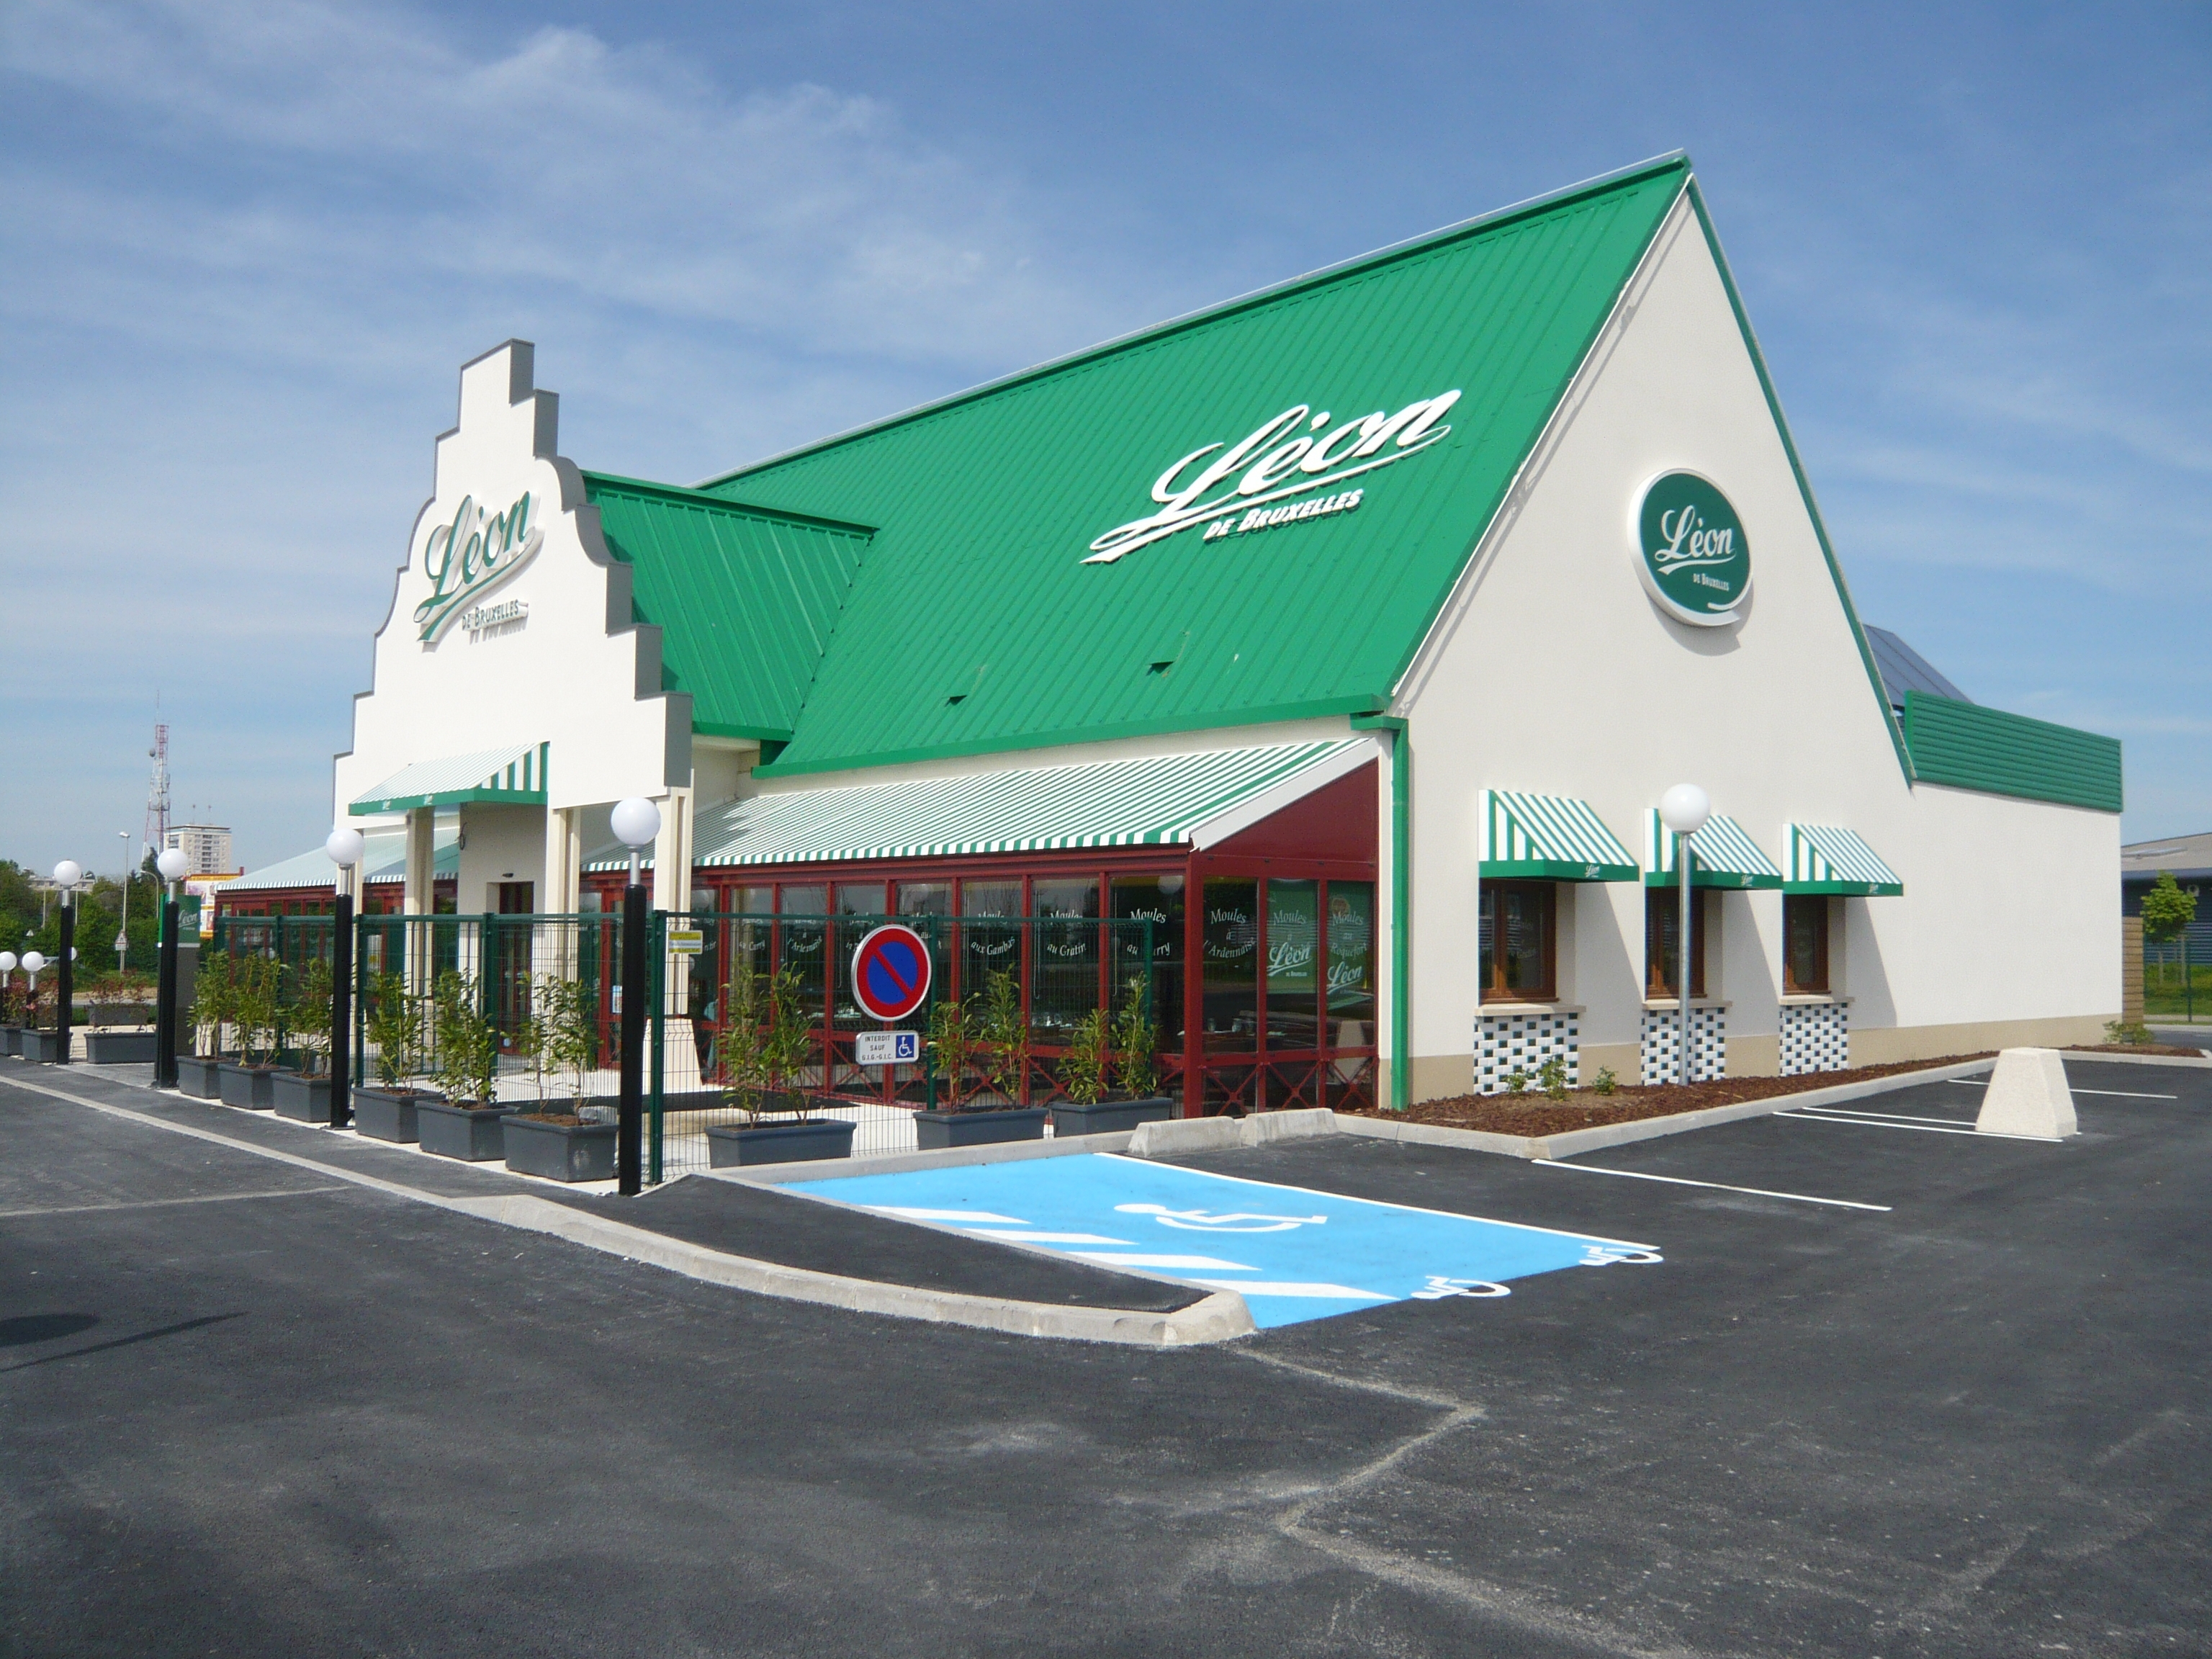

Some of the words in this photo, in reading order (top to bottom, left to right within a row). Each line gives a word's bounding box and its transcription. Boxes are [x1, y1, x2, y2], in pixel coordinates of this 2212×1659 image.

[1238, 488, 1364, 531] BRUXELLES
[1130, 908, 1166, 924] Moules
[1210, 907, 1247, 925] Moules
[1273, 909, 1307, 925] Moules
[1332, 911, 1364, 926] Moules
[986, 936, 1015, 956] Gambas
